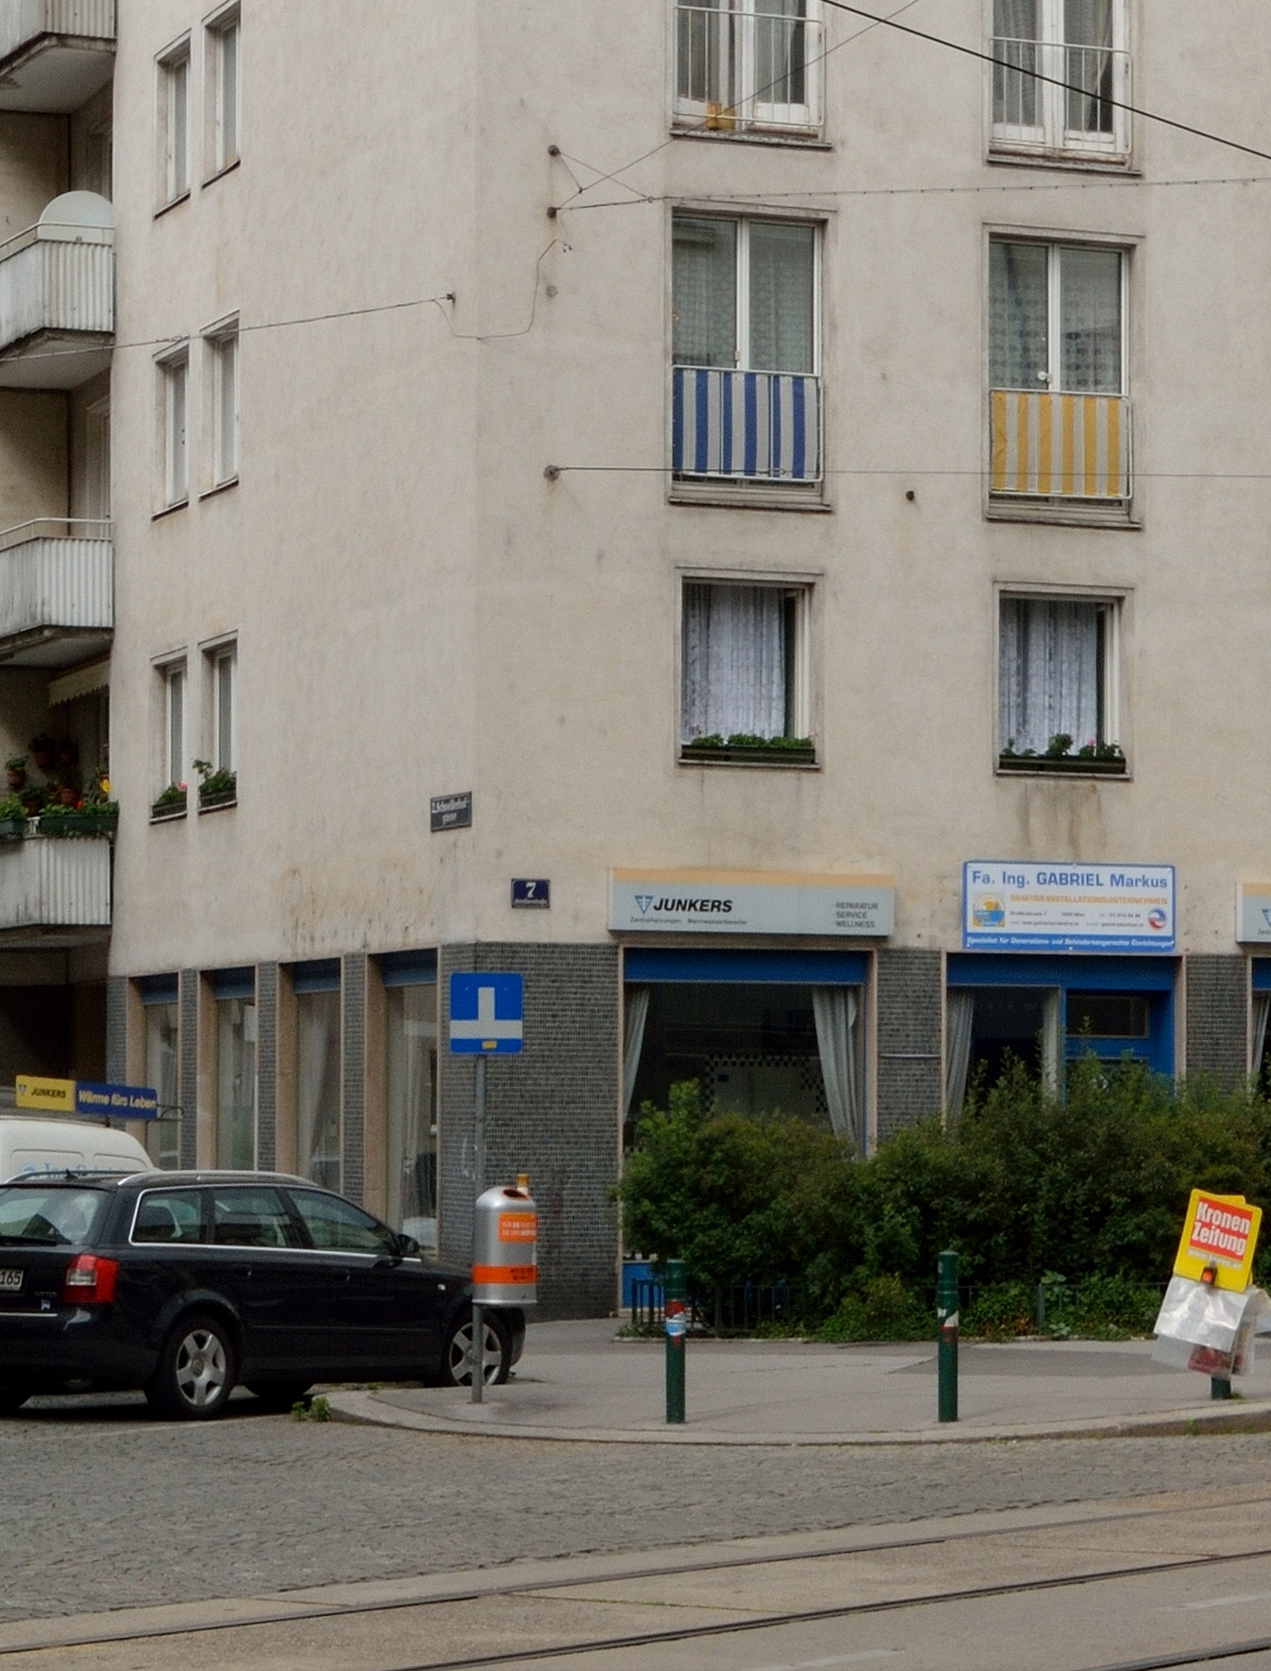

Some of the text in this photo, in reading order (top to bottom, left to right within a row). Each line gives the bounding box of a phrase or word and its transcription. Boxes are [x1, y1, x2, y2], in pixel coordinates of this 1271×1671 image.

[971, 870, 1168, 889] Fa. Ing. GABRIEL Markus
[525, 881, 537, 899] 7
[653, 898, 733, 913] JUNKERS
[30, 1088, 67, 1099] JUNKERS
[78, 1089, 110, 1105] Wärme
[130, 1095, 157, 1109] Leben
[1196, 1201, 1252, 1234] Kronen
[1191, 1221, 1247, 1257] Zeitung
